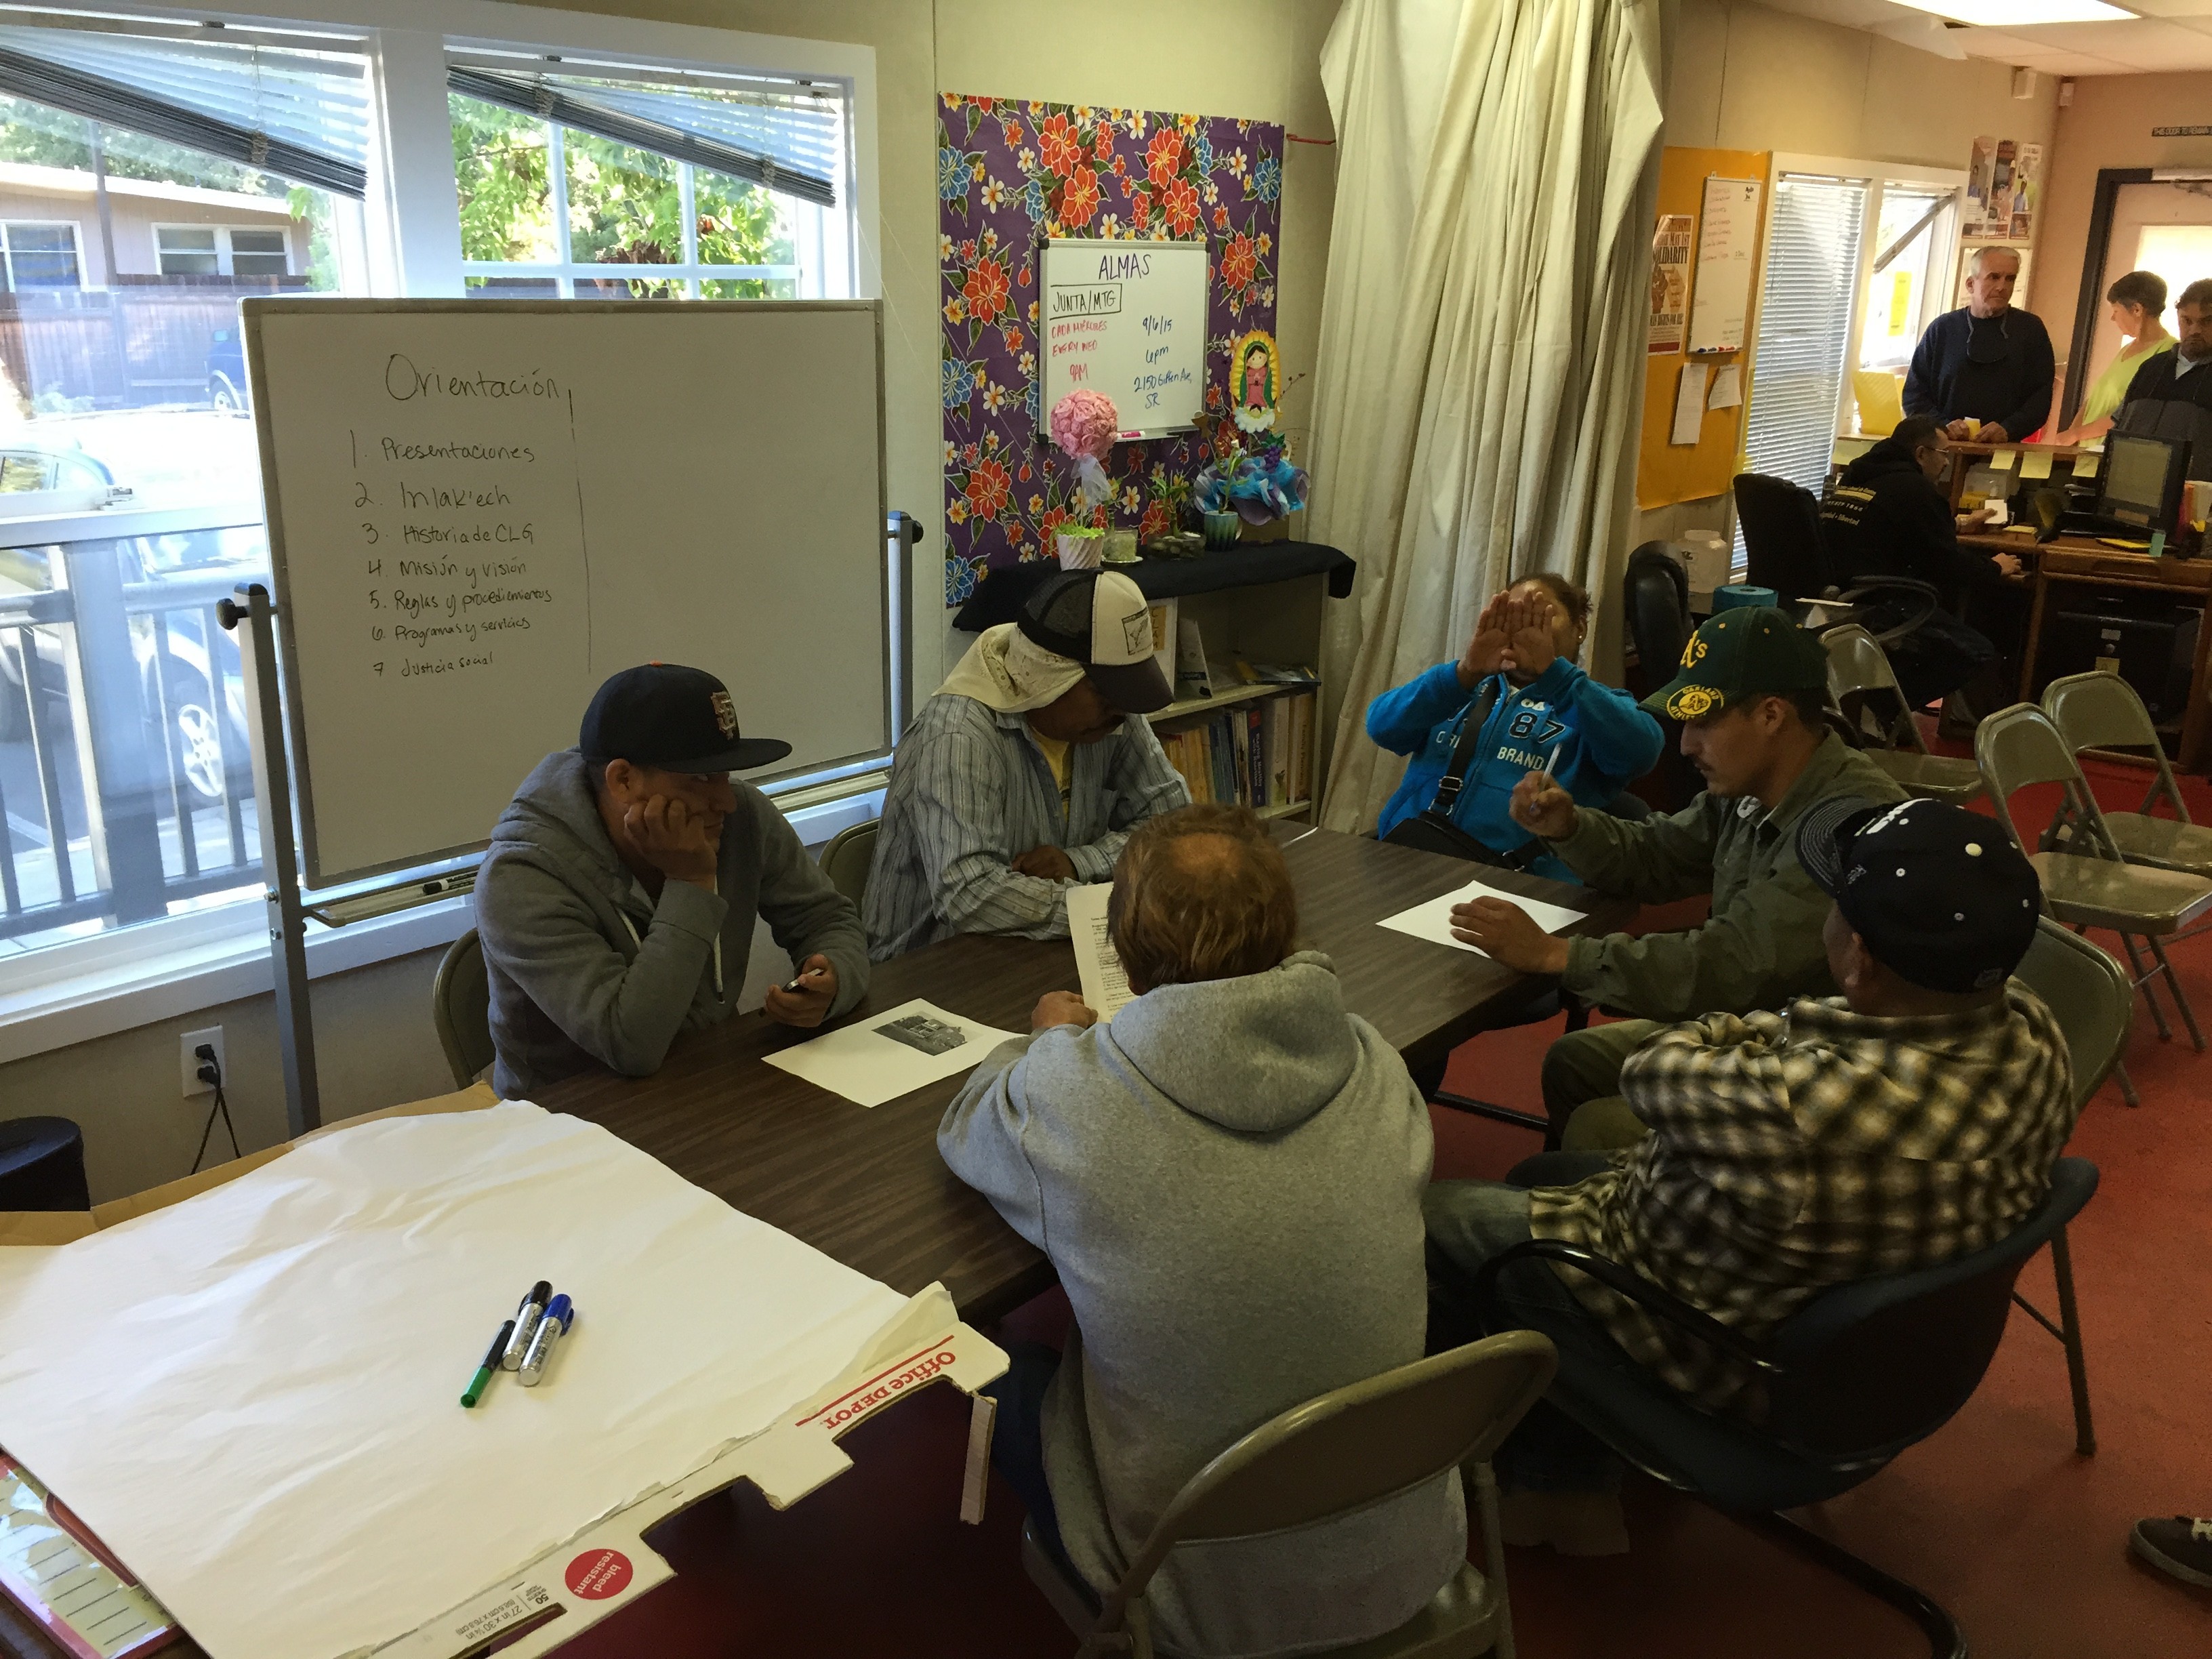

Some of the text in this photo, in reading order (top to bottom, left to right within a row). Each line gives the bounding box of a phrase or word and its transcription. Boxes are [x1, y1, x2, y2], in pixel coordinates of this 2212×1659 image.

[1099, 253, 1151, 281] ALMAS
[1052, 289, 1117, 314] JUNTA/MTG
[1052, 323, 1070, 339] CADA
[1052, 340, 1097, 357] EVERY WED
[1145, 346, 1169, 365] 6pm
[386, 353, 559, 401] Orientación
[1069, 363, 1088, 382] 9AM
[1134, 375, 1157, 392] 2150
[1145, 392, 1160, 409] SR
[381, 437, 535, 462] Presentaciones
[404, 525, 470, 544] Historia
[473, 525, 491, 541] de
[495, 523, 533, 544] CLG
[465, 567, 477, 589] y
[394, 590, 438, 619] Reglas
[446, 594, 456, 617] y
[394, 623, 462, 648] Programas
[465, 624, 476, 642] y
[1680, 630, 1708, 669] A's
[401, 658, 454, 677] Justicia
[459, 651, 493, 668] social
[1509, 712, 1565, 744] 87
[1497, 746, 1544, 771] BRAND
[822, 1351, 956, 1430] Office DEPOT
[573, 1551, 614, 1595] resistant
[592, 1563, 621, 1593] bleed
[511, 1605, 523, 1616] 27
[537, 1595, 549, 1605] 50
[483, 1620, 497, 1631] 30
[501, 1612, 511, 1620] in
[466, 1631, 475, 1639] in
